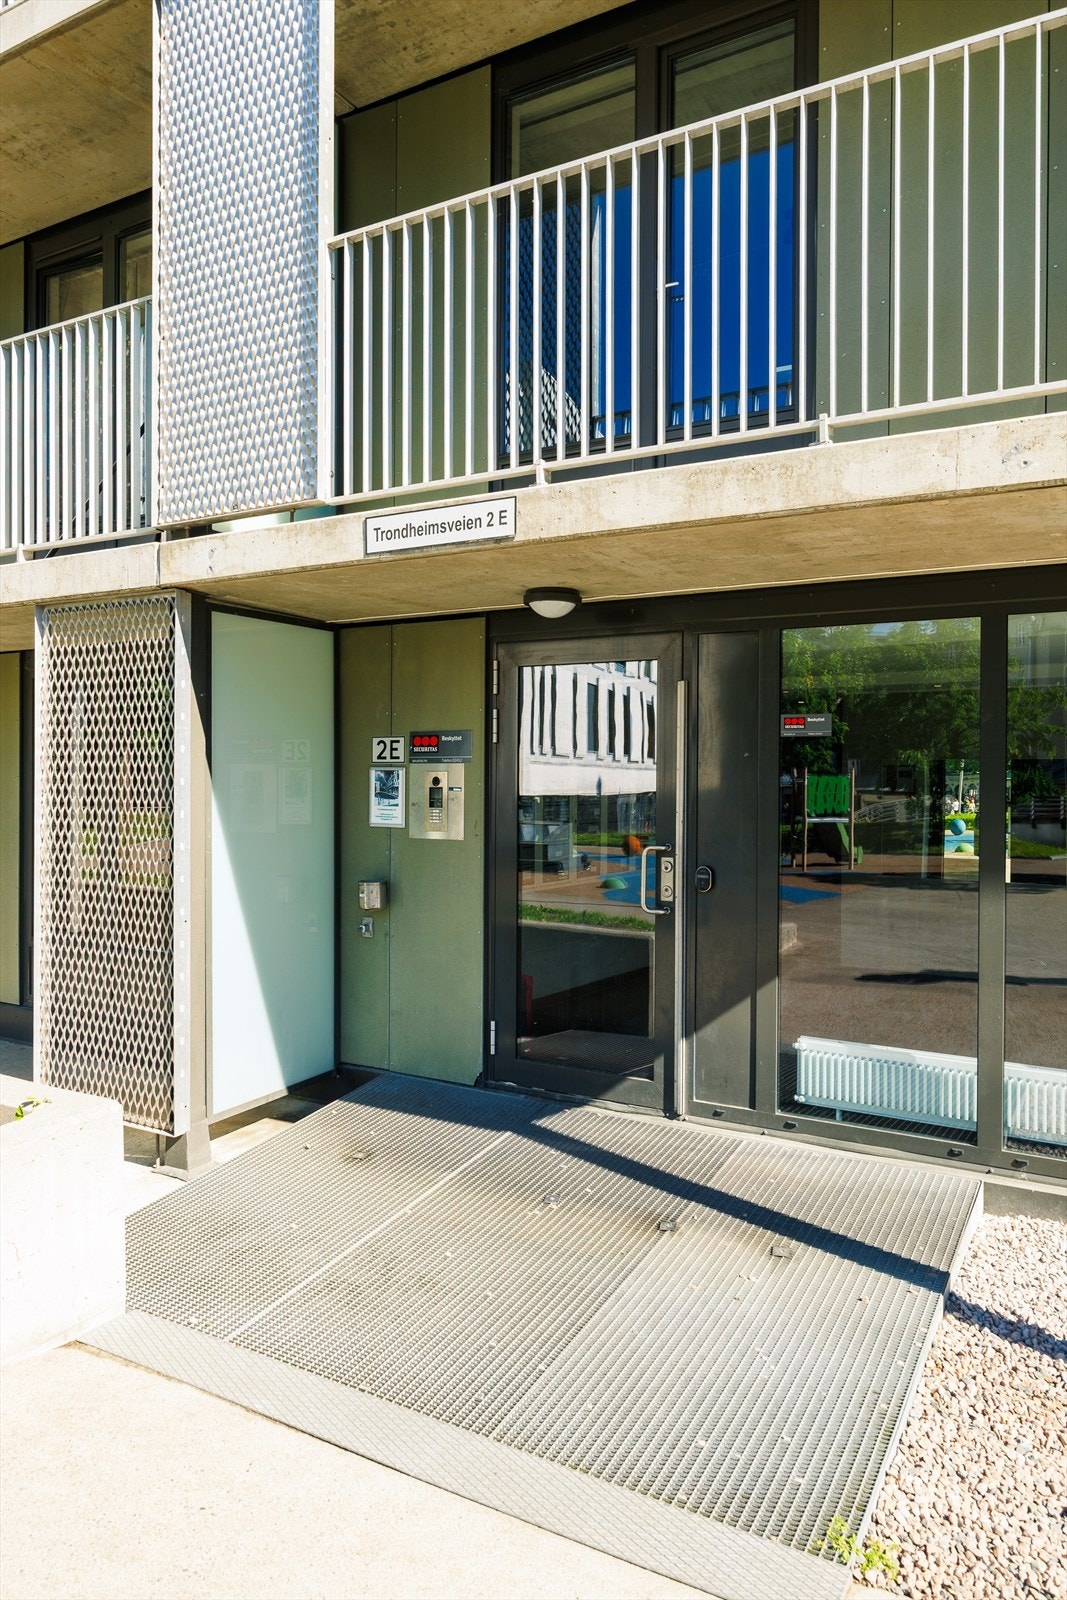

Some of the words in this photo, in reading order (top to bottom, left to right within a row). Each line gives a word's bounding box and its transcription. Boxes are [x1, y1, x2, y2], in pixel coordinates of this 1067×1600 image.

[373, 515, 482, 542] Trondheimsveien
[486, 511, 494, 528] 2
[498, 509, 508, 526] E
[376, 739, 400, 760] 2E
